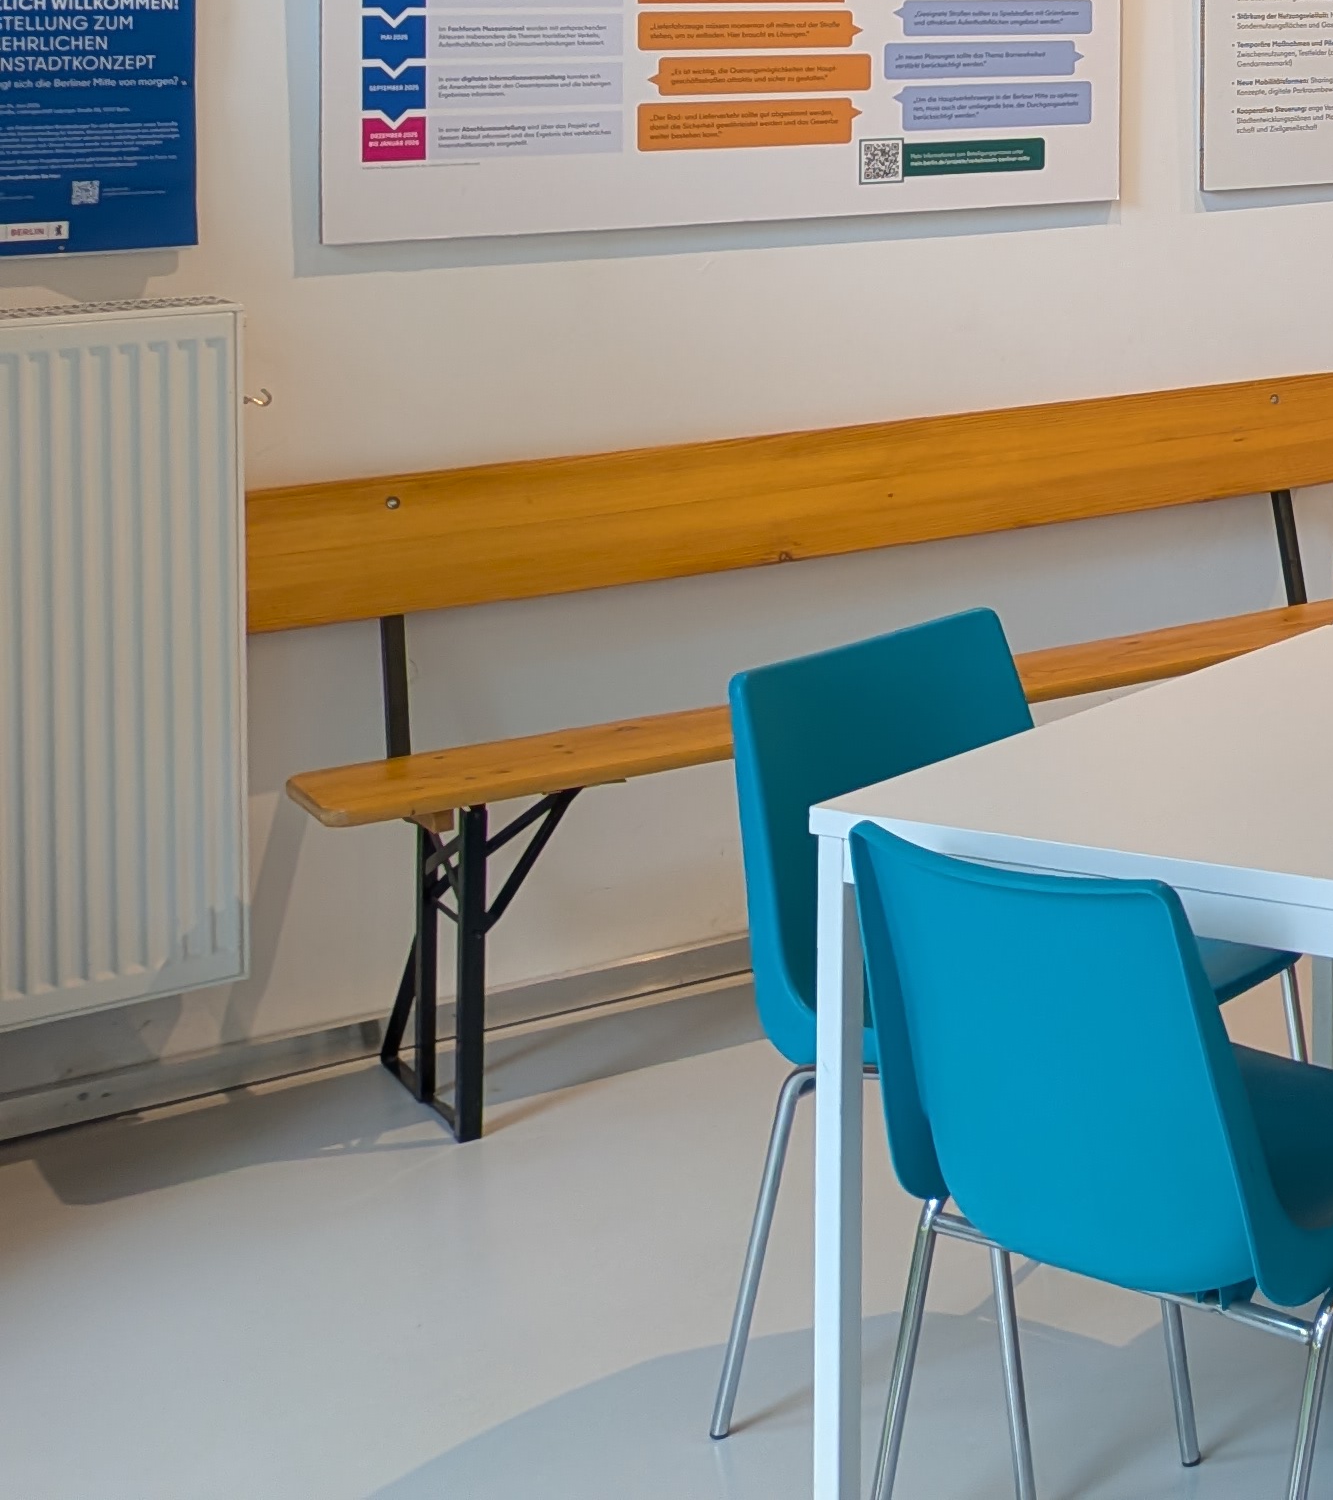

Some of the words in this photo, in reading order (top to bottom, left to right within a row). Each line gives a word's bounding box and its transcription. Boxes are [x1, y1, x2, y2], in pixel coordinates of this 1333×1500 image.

[93, 15, 134, 30] ZUM
[0, 36, 108, 51] EHRLICHEN
[35, 79, 51, 88] die
[53, 78, 91, 88] Berliner
[93, 77, 116, 87] Mitte
[118, 79, 136, 87] von
[138, 76, 178, 89] morgen?
[10, 228, 45, 236] BERLIN
